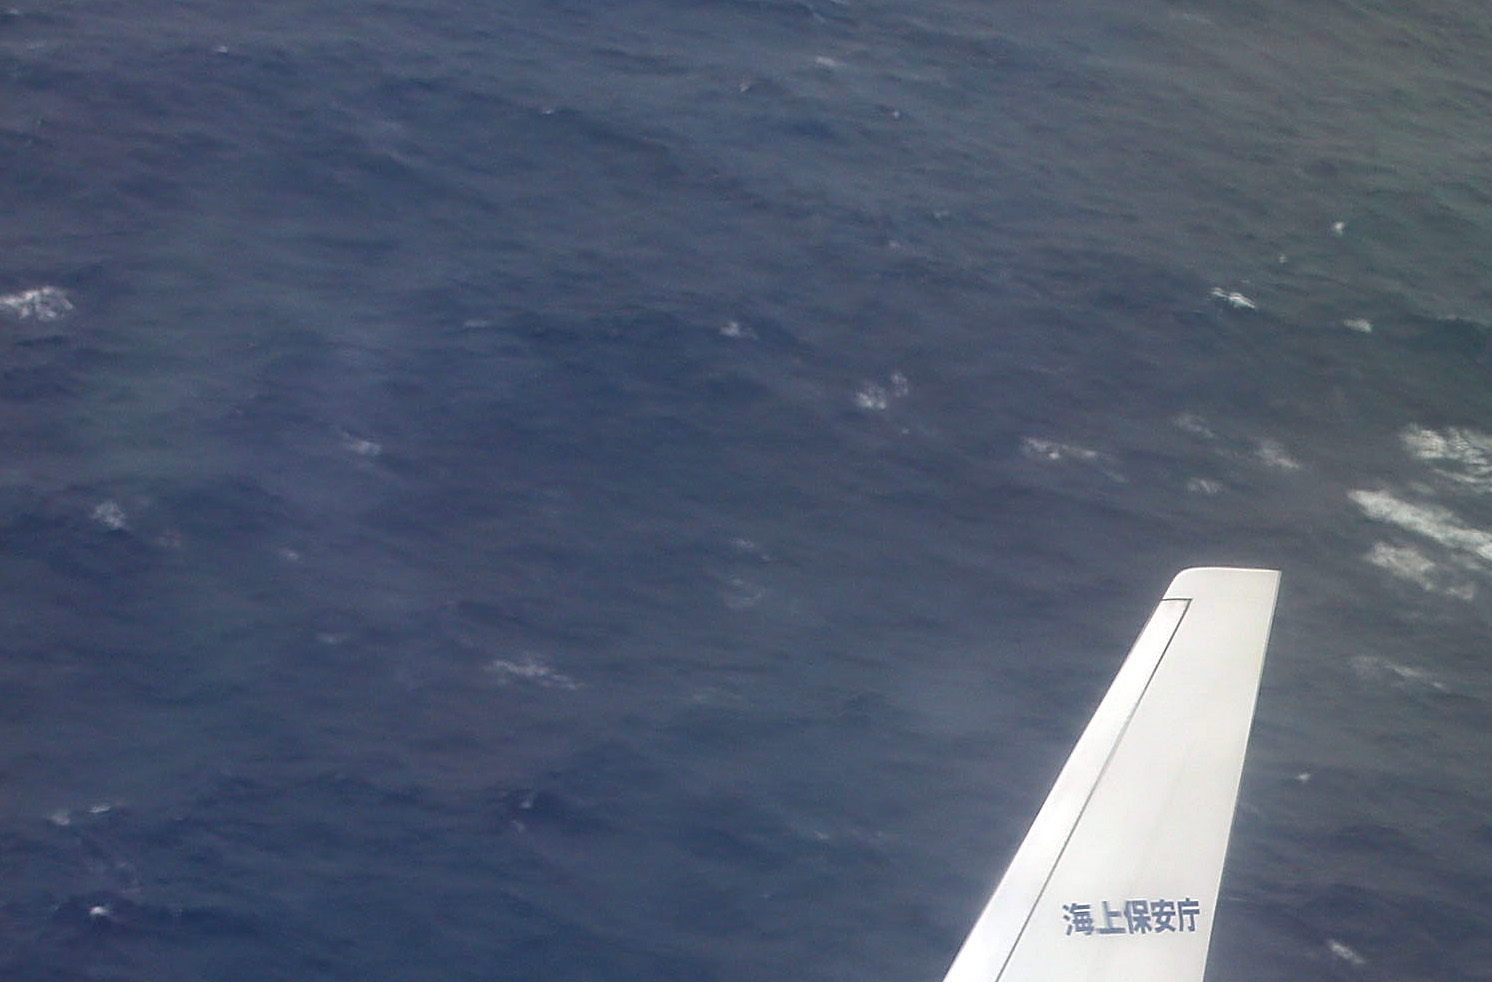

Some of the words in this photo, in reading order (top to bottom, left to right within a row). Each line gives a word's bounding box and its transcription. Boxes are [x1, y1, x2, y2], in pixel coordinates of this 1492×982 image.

[1062, 898, 1200, 935] 海上保安庁
